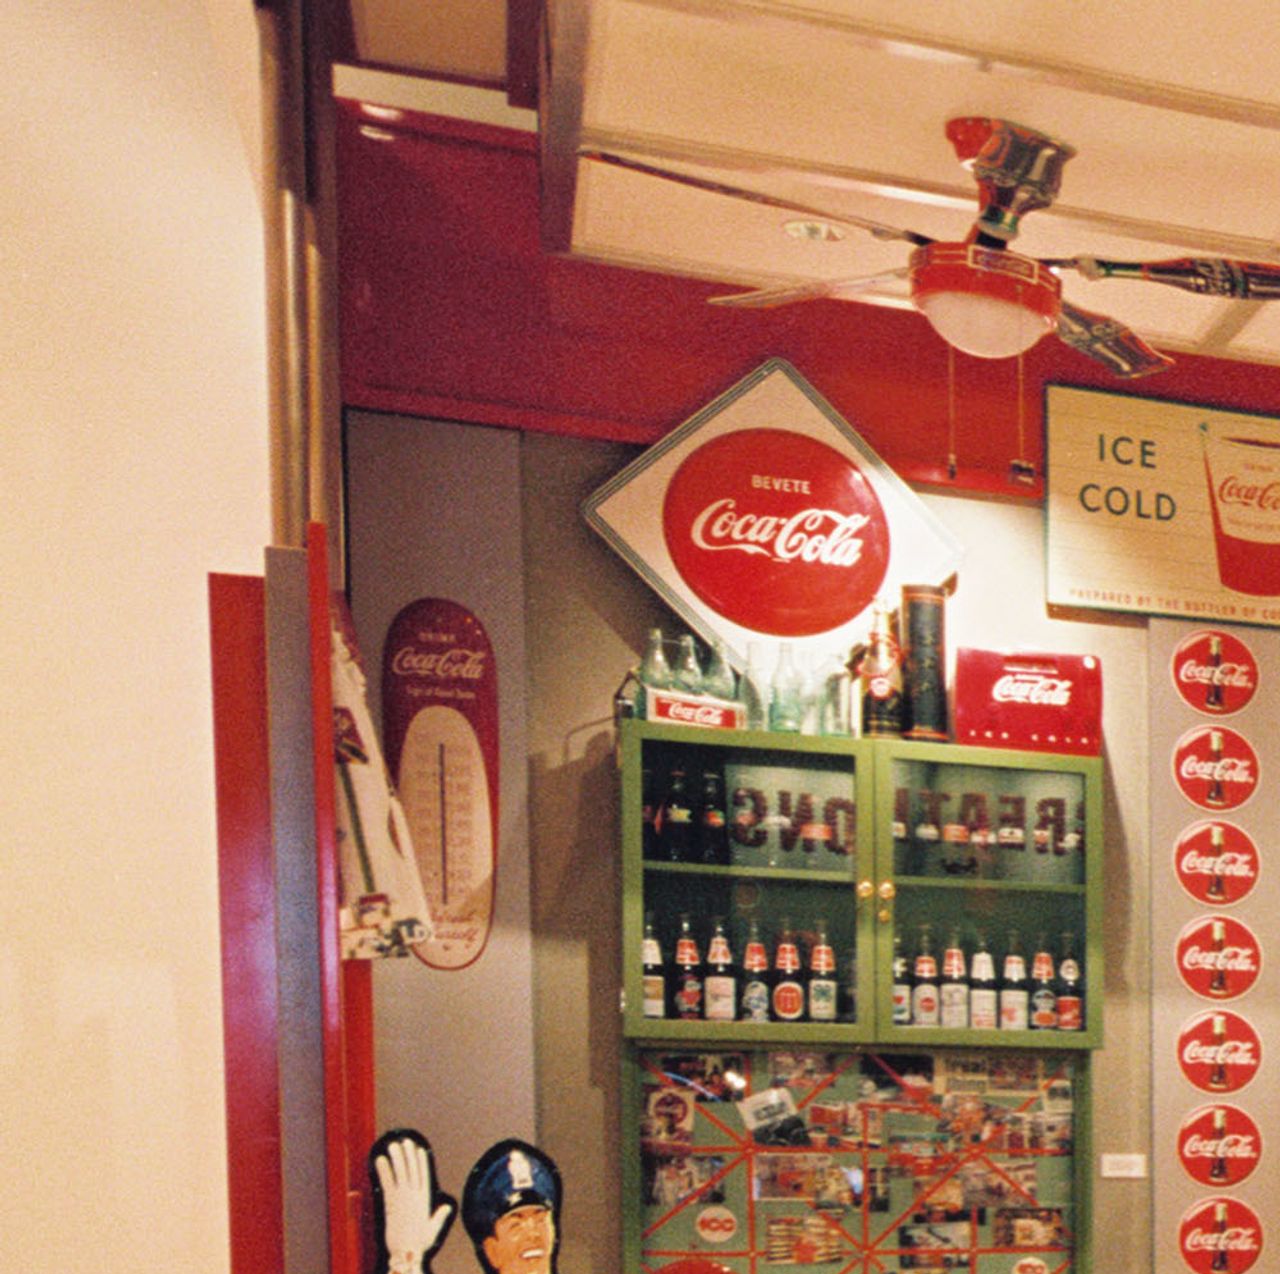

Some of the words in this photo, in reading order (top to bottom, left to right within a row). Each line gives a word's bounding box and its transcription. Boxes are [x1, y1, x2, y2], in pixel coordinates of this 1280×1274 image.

[1099, 434, 1156, 469] ICE
[752, 475, 811, 494] BEVETE
[1079, 483, 1176, 521] COLD
[691, 498, 870, 567] Coca-Cola
[1159, 599, 1179, 610] THE
[392, 646, 486, 679] Coca-Cola
[1180, 660, 1253, 688] Coca-Cola
[992, 673, 1073, 706] Coca-Cola
[669, 702, 723, 725] Coca-Cola
[1181, 755, 1254, 783] Coca-Cola
[1181, 850, 1254, 878] Coca-Cola
[1183, 946, 1256, 971] Coca-Cola
[1183, 1040, 1256, 1066] Coca-Cola
[1183, 1134, 1257, 1158] Coca-Cola
[1185, 1228, 1258, 1251] Coca-Cola
